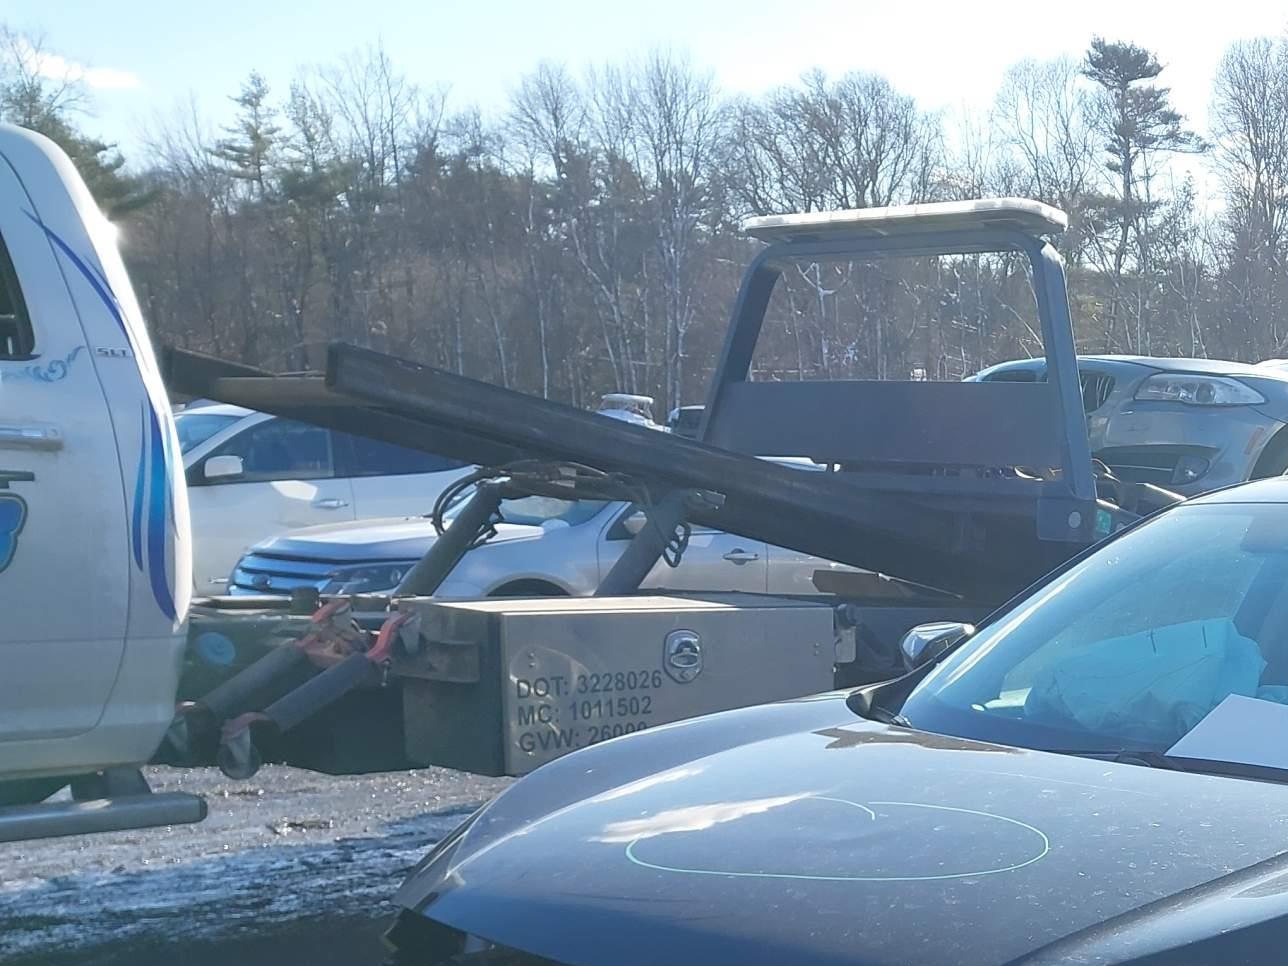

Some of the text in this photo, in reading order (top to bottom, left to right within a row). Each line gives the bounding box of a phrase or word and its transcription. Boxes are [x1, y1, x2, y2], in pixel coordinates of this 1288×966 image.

[97, 346, 127, 358] SLT
[516, 670, 662, 698] DOT: 3228026
[518, 696, 653, 726] MC: 1011502
[519, 727, 580, 752] GVW:
